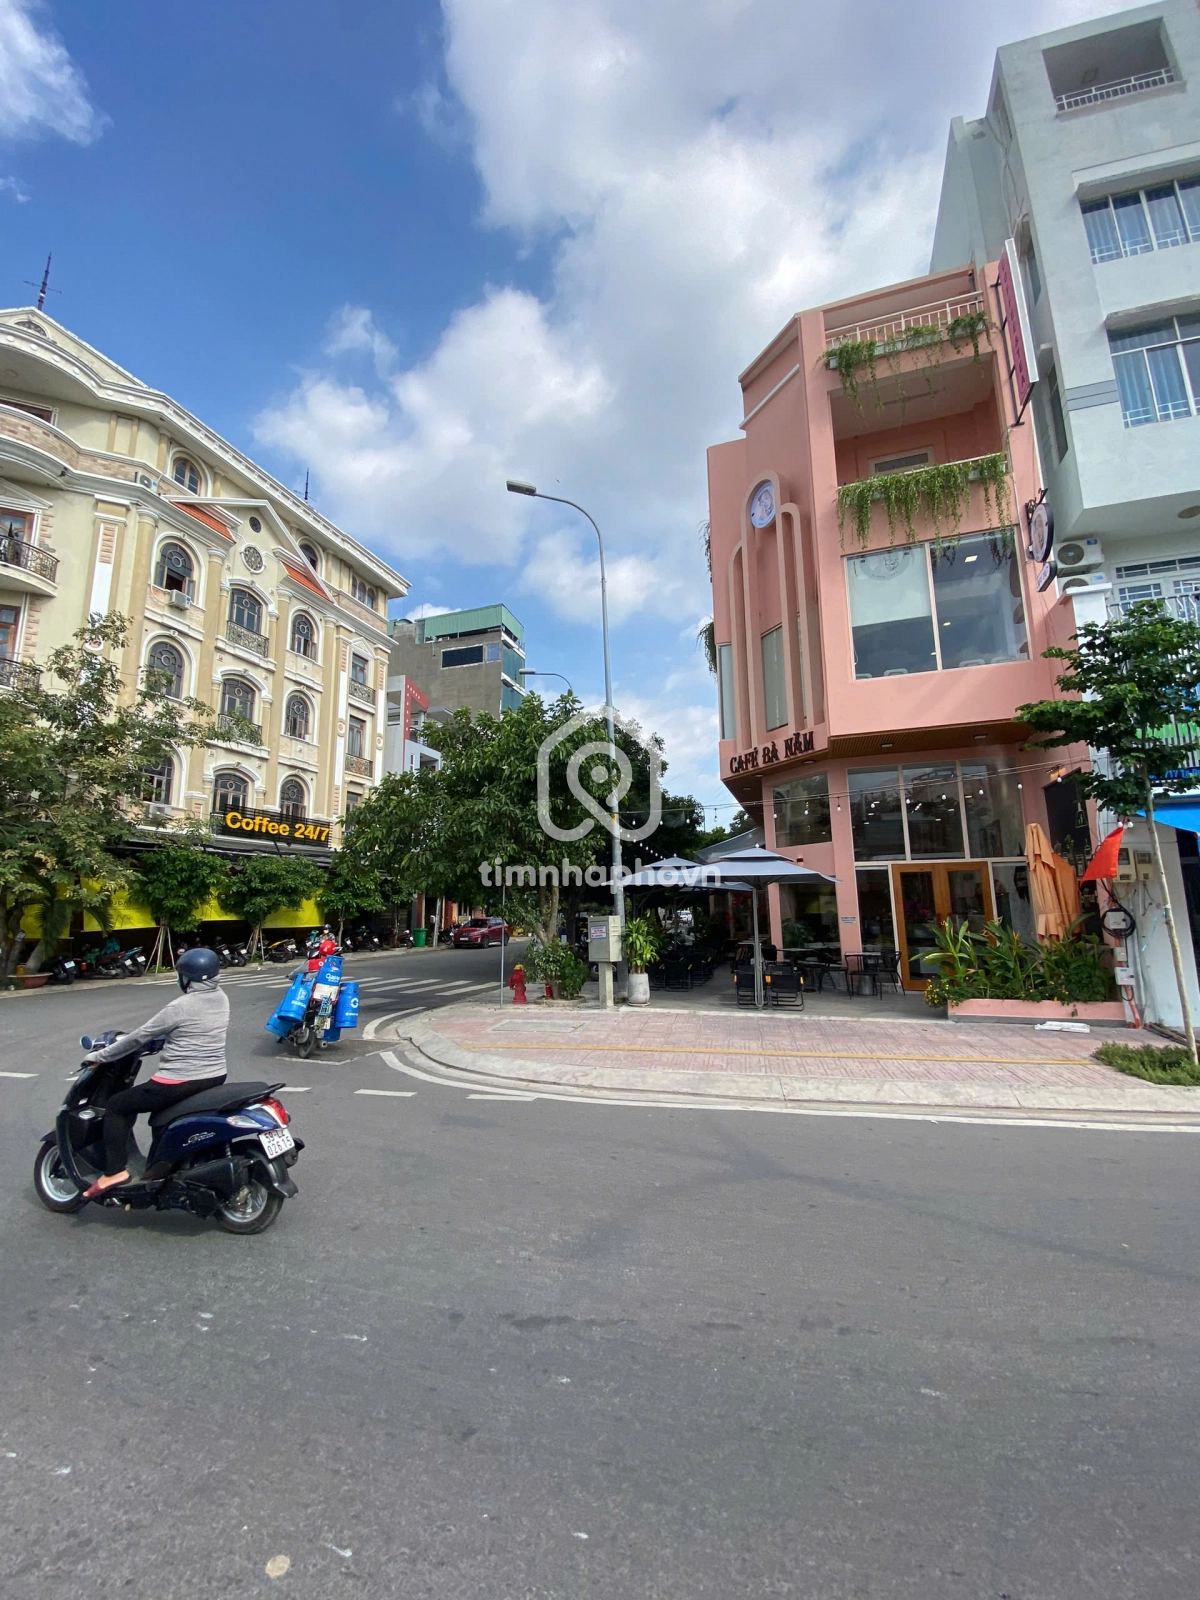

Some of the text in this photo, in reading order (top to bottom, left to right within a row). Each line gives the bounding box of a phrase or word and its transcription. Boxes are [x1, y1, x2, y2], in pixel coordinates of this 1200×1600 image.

[730, 731, 815, 774] CAFÉ BÀ NĂM
[225, 811, 330, 841] Coffee 24/7
